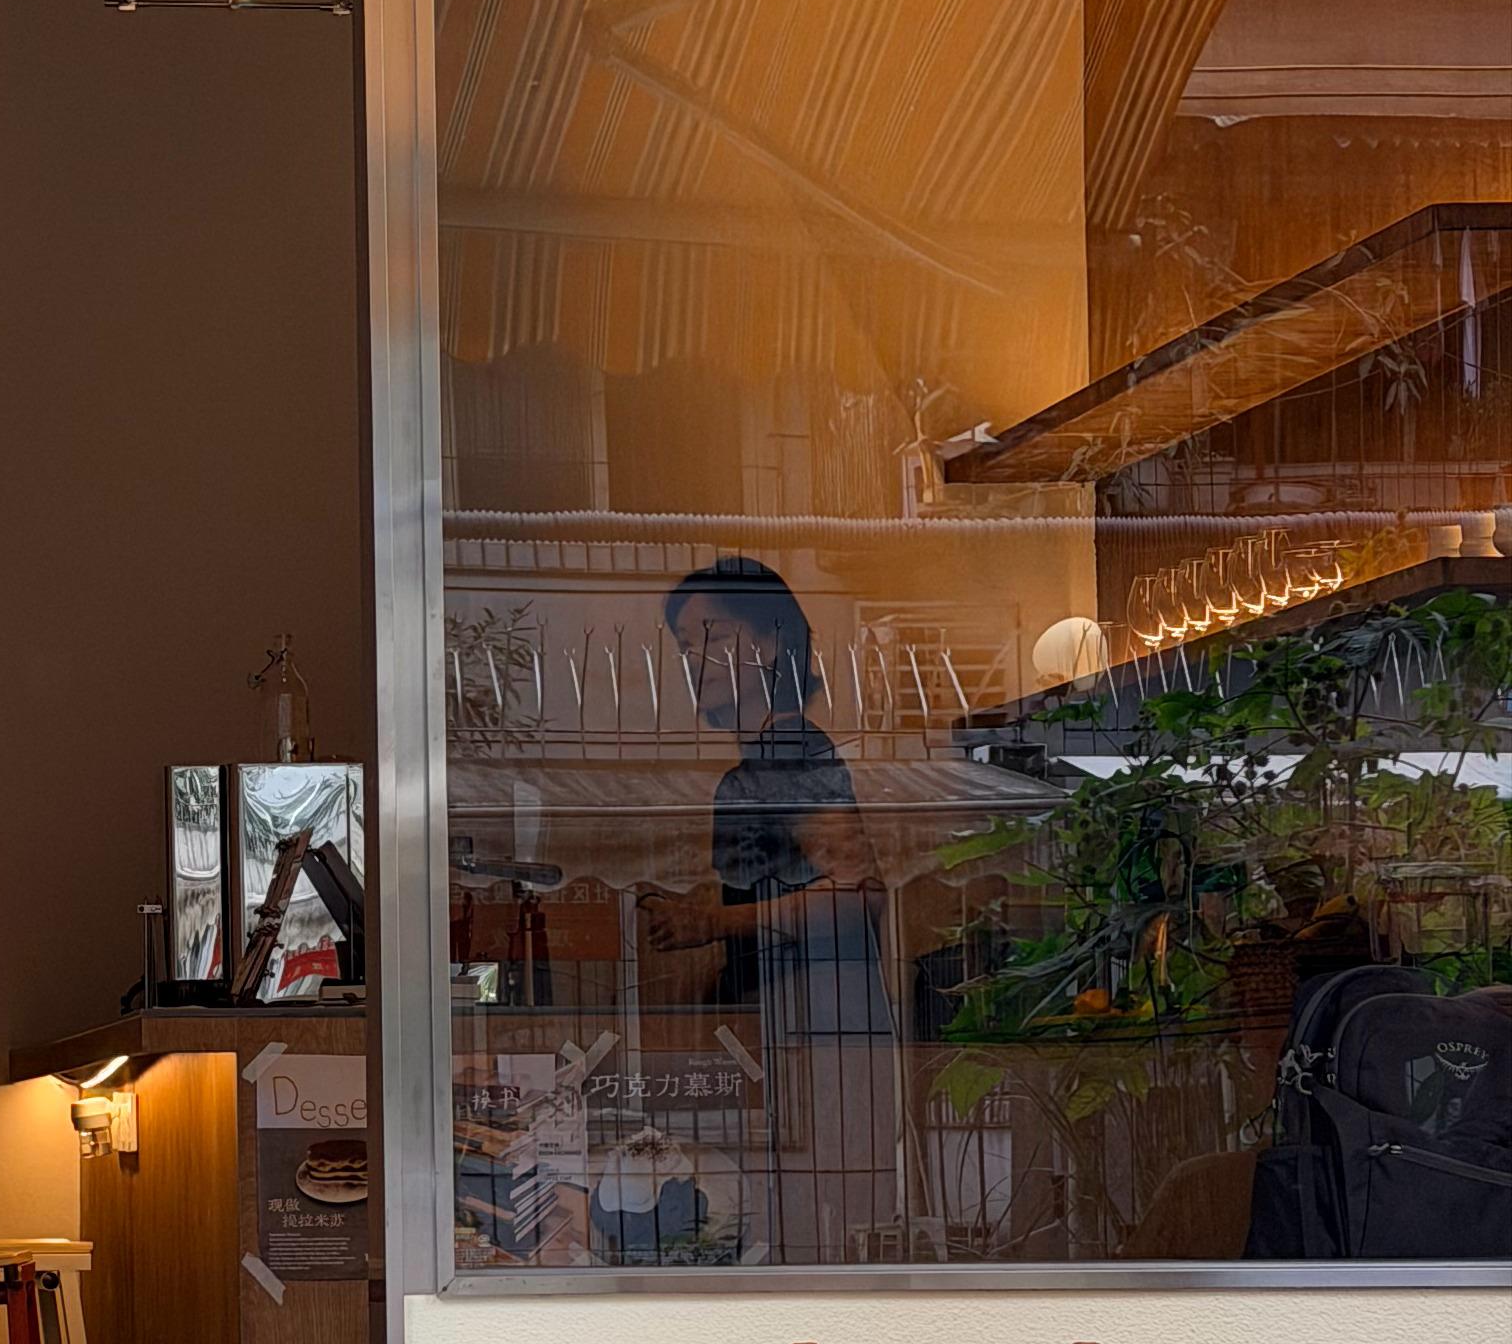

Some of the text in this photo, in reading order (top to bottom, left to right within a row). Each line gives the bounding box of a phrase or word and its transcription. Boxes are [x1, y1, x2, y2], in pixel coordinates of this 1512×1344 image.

[1436, 1041, 1489, 1060] OSPREY
[590, 1071, 743, 1099] 巧克力慕斯
[283, 1214, 345, 1228] 提拉米苏
